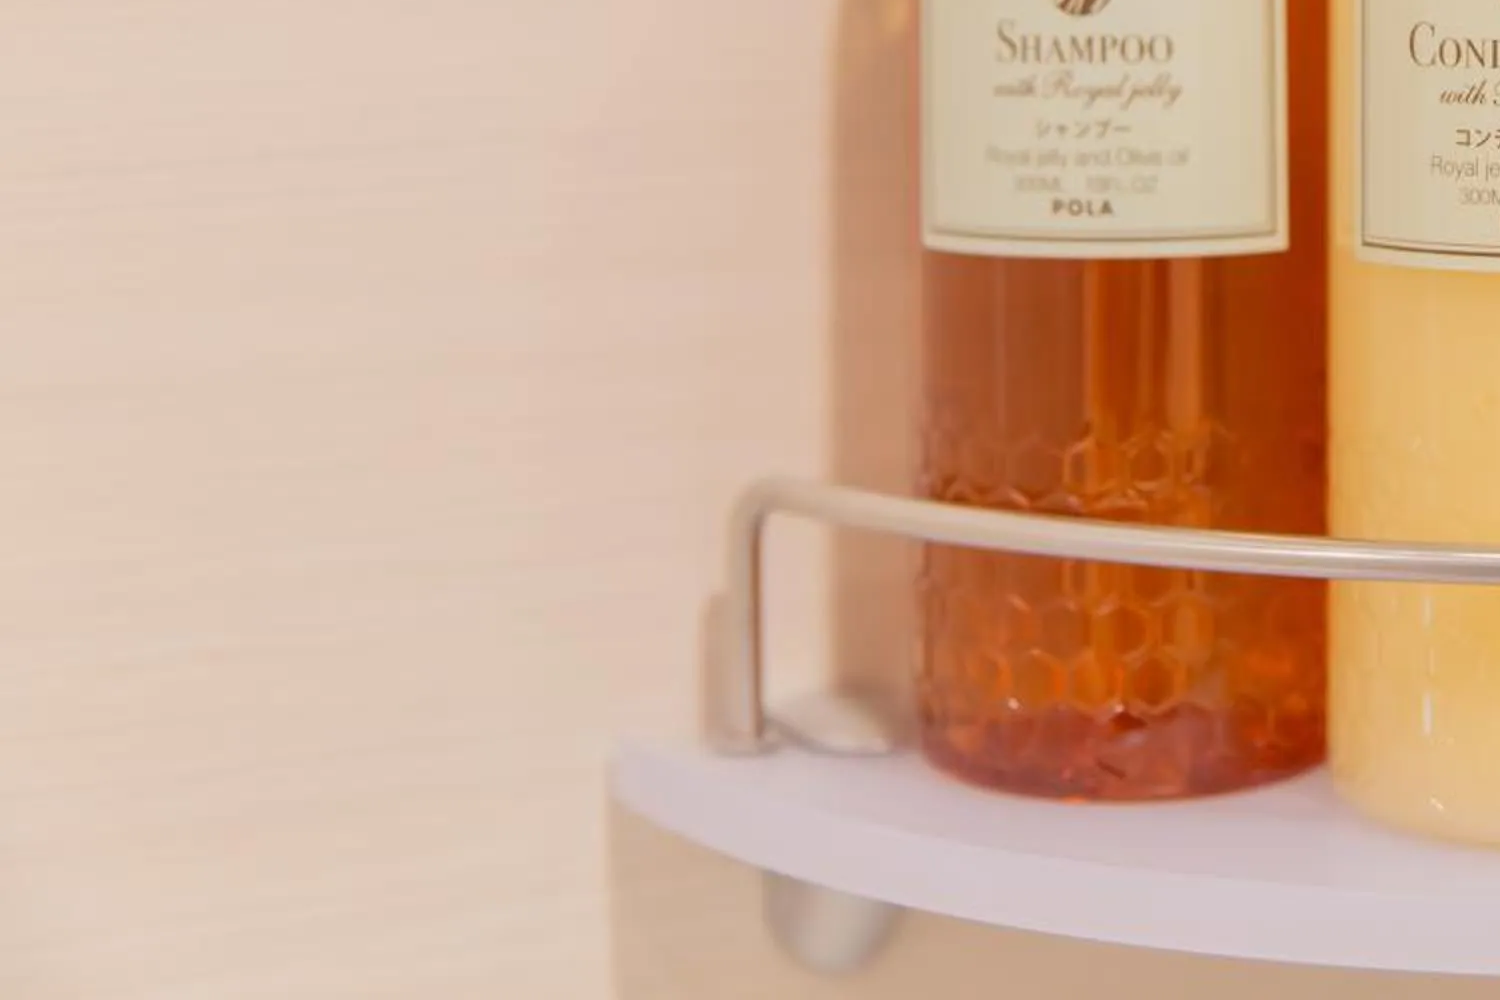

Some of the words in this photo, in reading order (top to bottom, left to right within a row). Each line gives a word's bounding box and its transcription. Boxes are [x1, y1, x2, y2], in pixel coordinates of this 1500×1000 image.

[995, 18, 1175, 65] SHAMPOO
[1439, 78, 1487, 107] with
[1430, 155, 1479, 181] Royal
[1052, 197, 1114, 217] POLA
